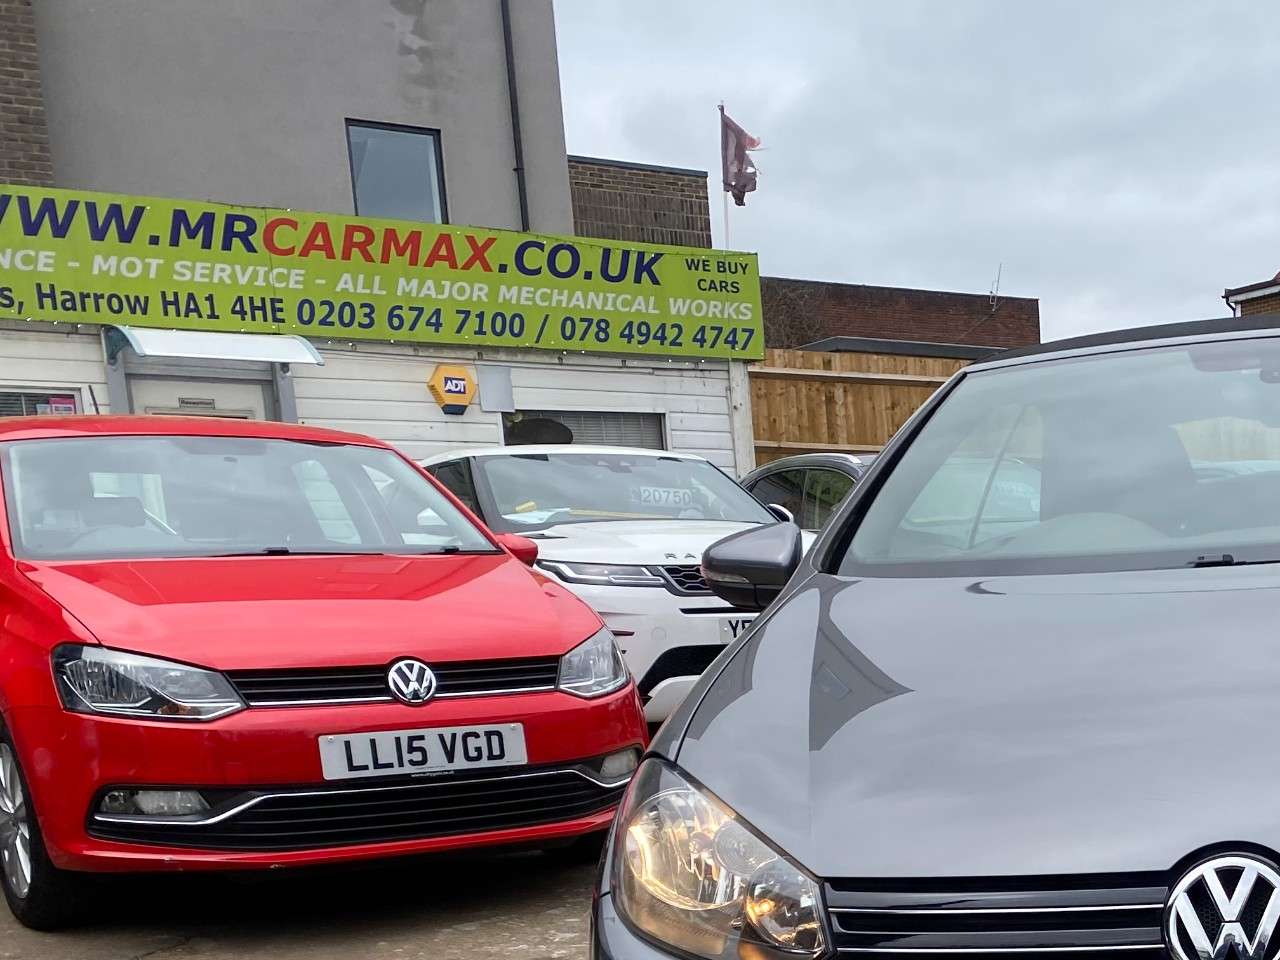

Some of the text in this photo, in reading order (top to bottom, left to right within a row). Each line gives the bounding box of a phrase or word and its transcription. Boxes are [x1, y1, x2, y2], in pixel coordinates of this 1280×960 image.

[0, 194, 666, 286] WW.MRCARMAX.CO.UK
[91, 254, 164, 280] MOT
[172, 260, 305, 289] SERVICE
[334, 272, 388, 296] ALL
[396, 277, 489, 303] MAJOR
[498, 284, 659, 314] MECHANICAL
[668, 297, 754, 321] WORKS
[686, 258, 749, 276] WE BUY
[697, 278, 740, 294] CARS
[35, 282, 150, 314] Harrow
[160, 290, 220, 320] HA1
[230, 296, 286, 324] 4HE
[296, 299, 376, 330] 0203
[386, 304, 444, 334] 674
[455, 308, 525, 338] 7100
[535, 314, 550, 344] /
[560, 316, 611, 343] 078
[619, 320, 684, 348] 4942
[692, 325, 755, 351] 4747
[444, 378, 466, 393] ADT
[343, 729, 506, 772] LL15 VGD
